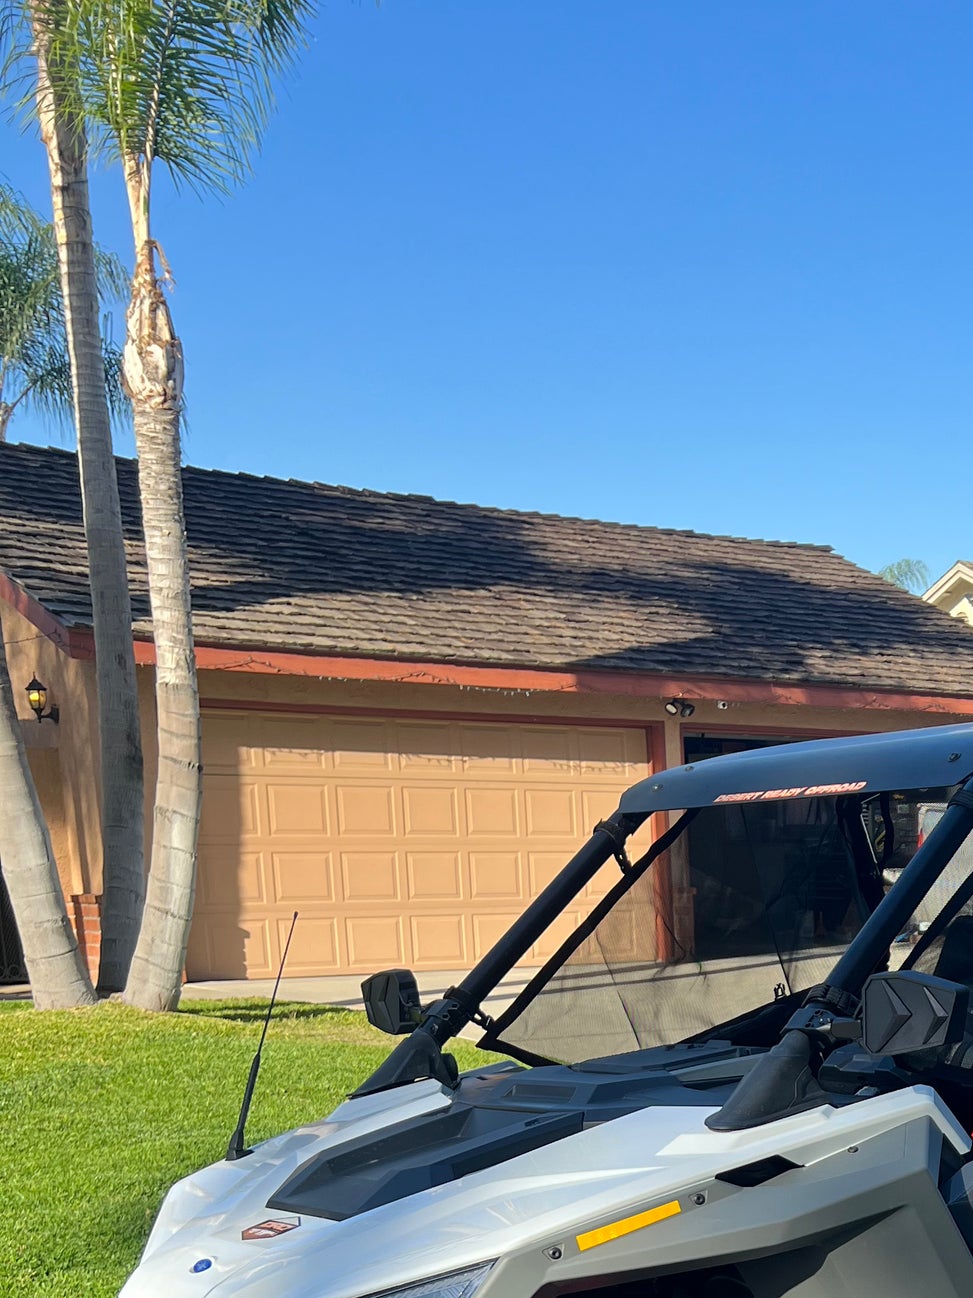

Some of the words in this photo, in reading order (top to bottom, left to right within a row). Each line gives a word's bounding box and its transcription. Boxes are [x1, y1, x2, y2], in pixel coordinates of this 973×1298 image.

[713, 792, 765, 803] DESERT
[761, 787, 807, 799] READY
[804, 781, 867, 796] OFFROAD
